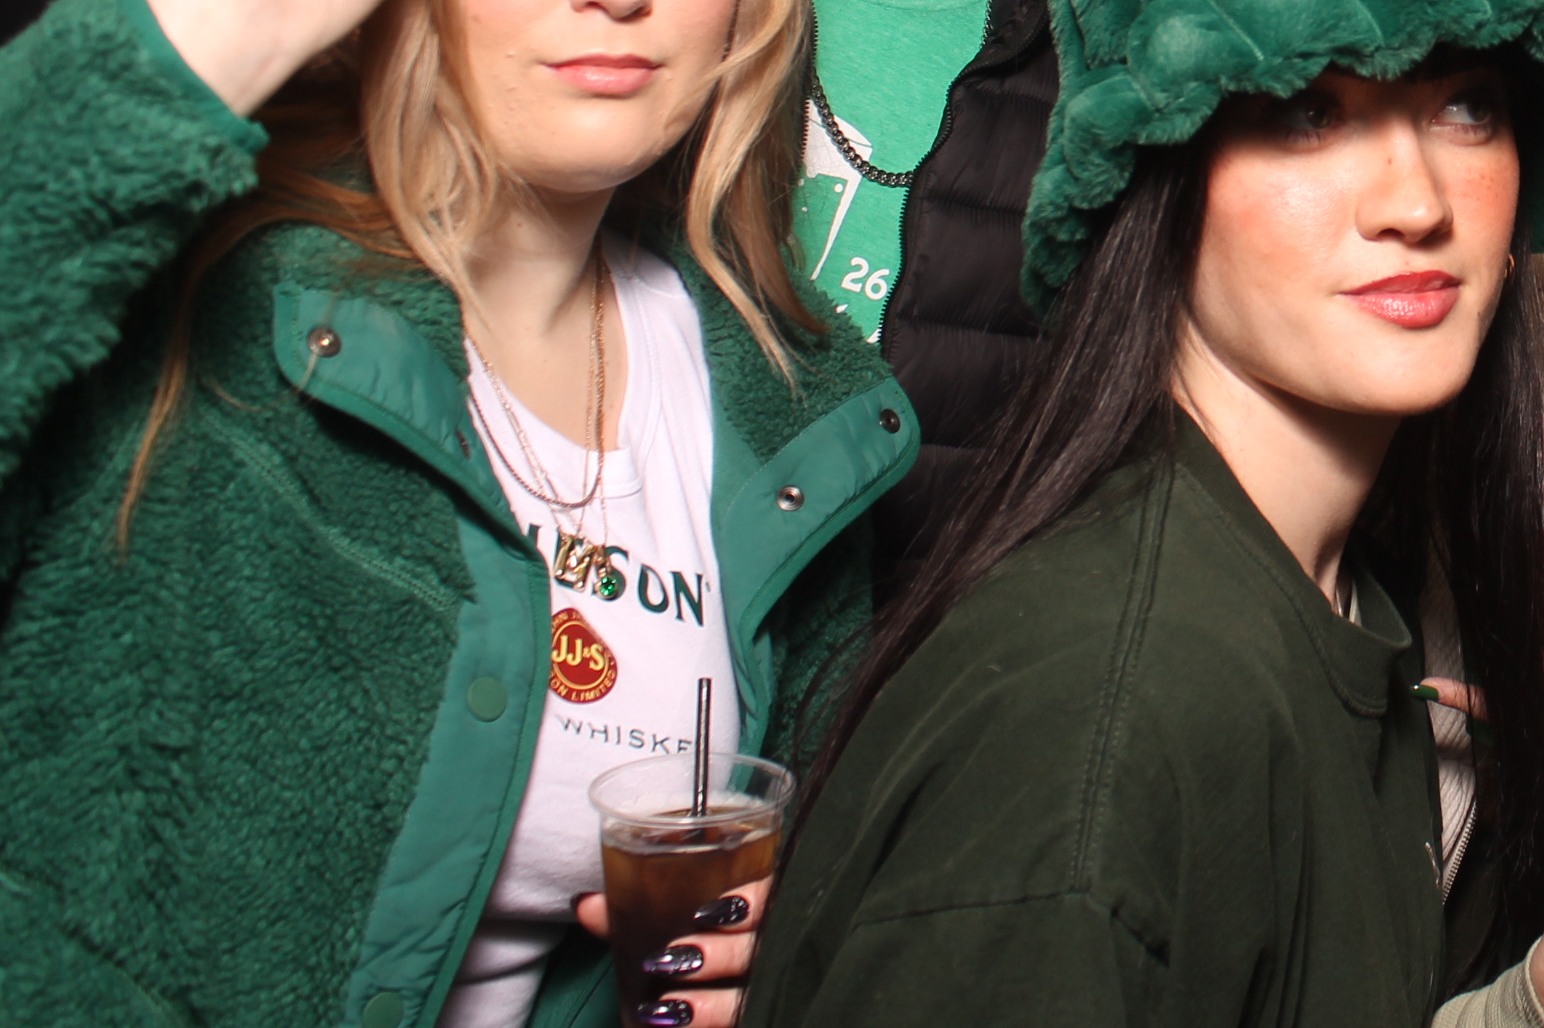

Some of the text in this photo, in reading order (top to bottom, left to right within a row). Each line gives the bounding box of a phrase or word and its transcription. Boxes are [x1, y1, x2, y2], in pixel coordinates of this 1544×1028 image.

[840, 256, 890, 300] 26
[550, 634, 605, 671] JJ&S
[571, 670, 615, 702] LIMITED
[555, 714, 692, 755] WHISKE
